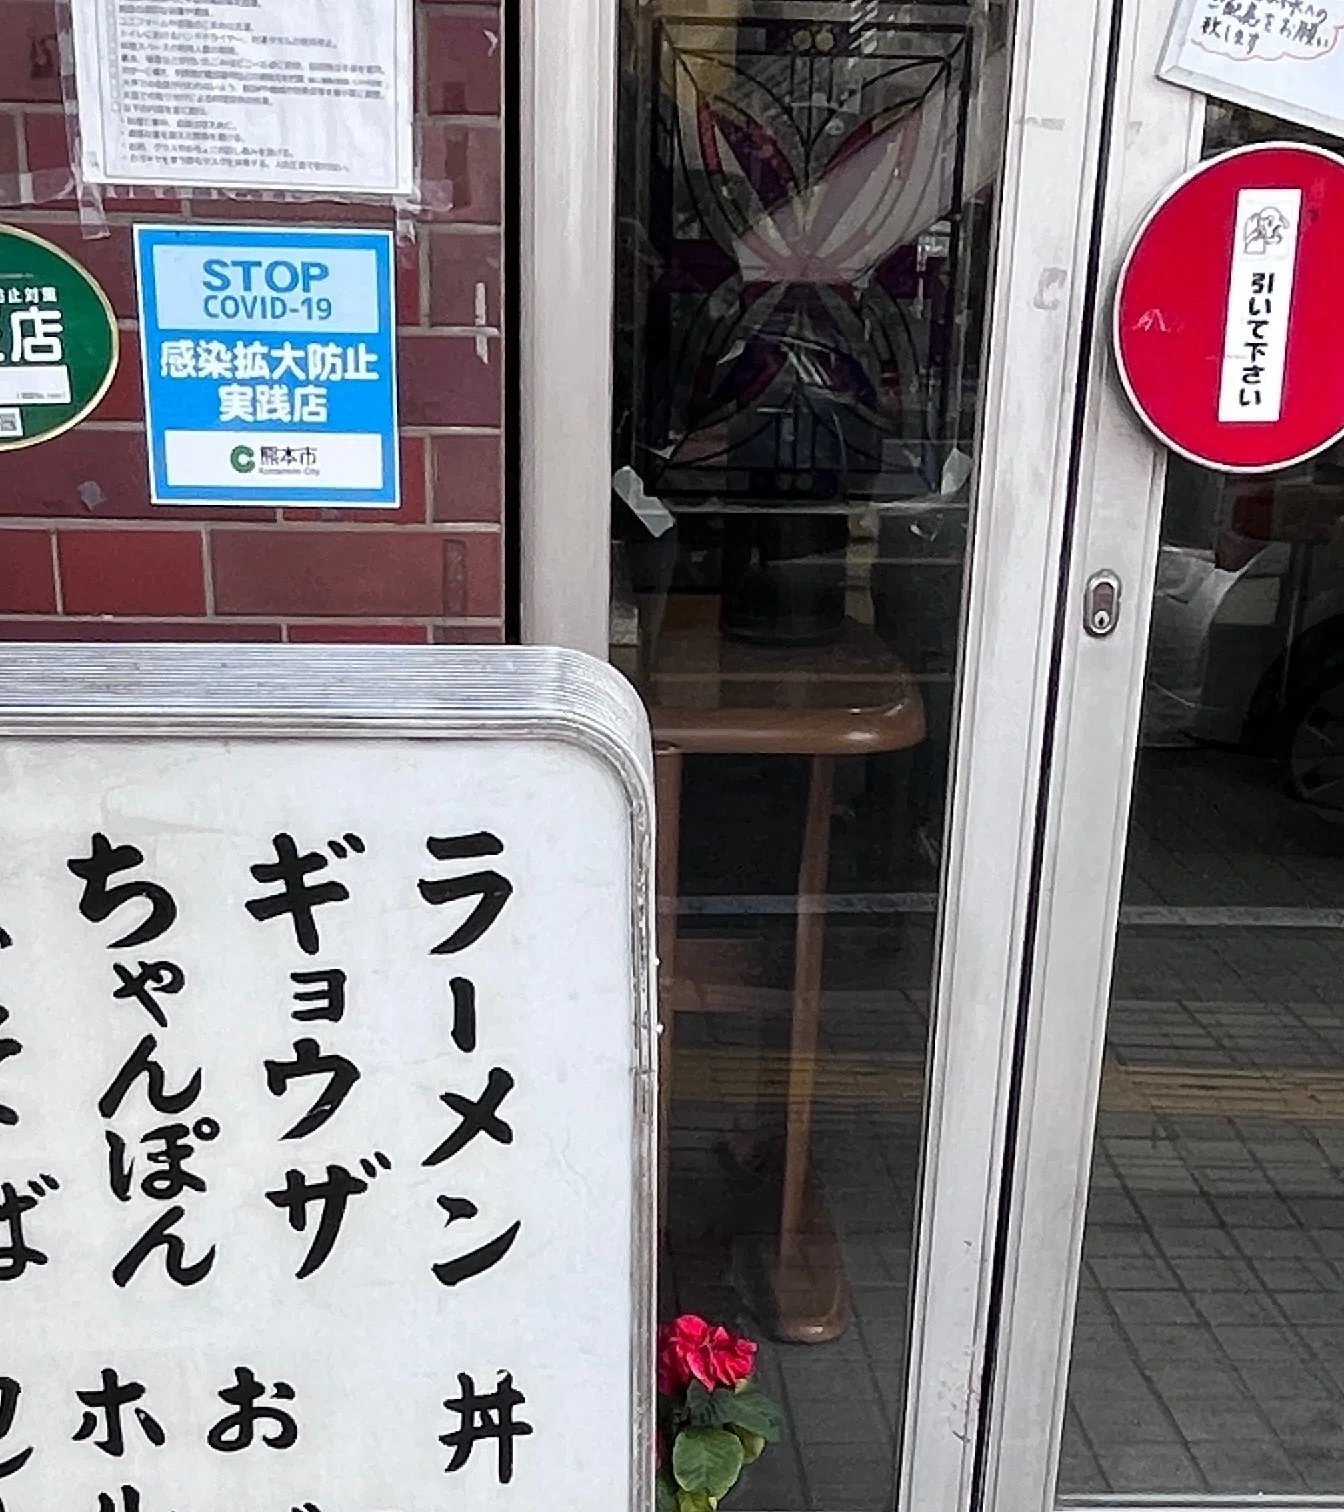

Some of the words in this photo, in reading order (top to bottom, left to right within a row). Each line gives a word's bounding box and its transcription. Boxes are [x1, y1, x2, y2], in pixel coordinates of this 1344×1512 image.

[202, 259, 329, 293] STOP
[203, 295, 333, 320] COVID-19
[160, 339, 380, 382] 感染拡大防止
[1238, 272, 1275, 407] 引いて下さい
[218, 383, 328, 424] 実践店
[67, 833, 220, 1287] ちゃんぽん
[245, 833, 391, 1279] ギョウザ
[417, 831, 521, 1286] ラーメン
